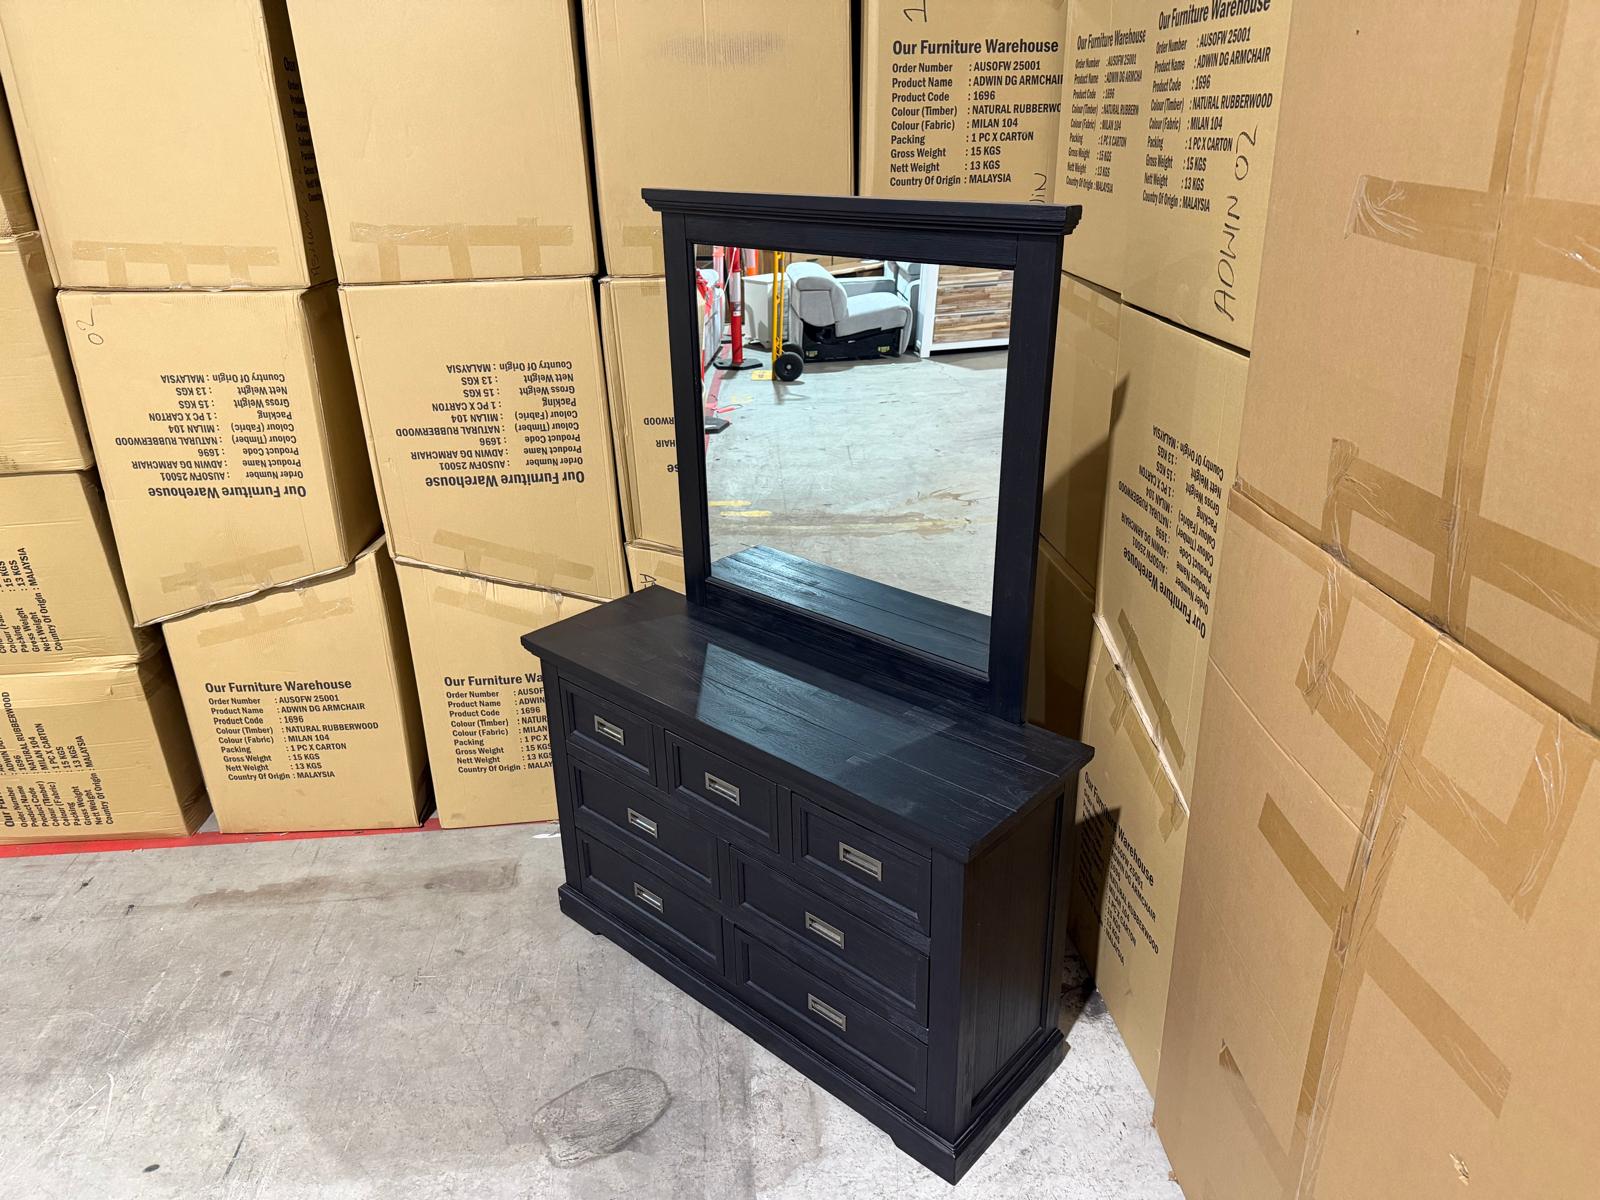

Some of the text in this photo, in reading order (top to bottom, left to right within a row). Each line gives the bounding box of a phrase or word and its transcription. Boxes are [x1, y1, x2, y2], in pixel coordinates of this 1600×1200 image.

[1158, 11, 1171, 30] Our
[1171, 4, 1209, 27] Furniture
[1077, 28, 1146, 50] Our Furniture Warehouse
[1156, 41, 1168, 54] Order
[1168, 37, 1187, 52] Number
[1227, 26, 1251, 44] 25001
[892, 38, 1058, 55] Our Furniture Warehouse
[892, 60, 1040, 73] Order Number AUSOFW 25001
[1153, 59, 1170, 73] Product
[1170, 58, 1185, 71] Name
[1218, 51, 1229, 66] DG
[1229, 46, 1271, 65] ARMCHAIR
[892, 77, 926, 88] Product
[927, 77, 952, 87] Name
[972, 75, 1002, 86] ADWIN
[1004, 75, 1017, 85] DG
[1152, 78, 1168, 92] Product
[1168, 77, 1181, 91] Code
[891, 90, 995, 102] Product Code 1696
[1150, 98, 1164, 111] Colour
[1163, 97, 1184, 113] (Timber)
[1220, 92, 1272, 109] RUBBERWOOD
[891, 106, 920, 116] Colour
[921, 105, 957, 118] (Timber)
[972, 104, 1011, 114] NATURAL
[891, 117, 1018, 131] Colour (Fabric) MILAN 104
[1148, 117, 1162, 129] Colour
[1162, 116, 1181, 132] (Fabric)
[1209, 116, 1222, 130] 104
[890, 131, 1033, 146] Packing 1 PC X CARTON
[890, 145, 1000, 159] Gross Weight 15 KGS
[890, 159, 1000, 174] Nett Weight 13 KGS
[889, 173, 1011, 187] Country Of Origin MALAYSIA
[1214, 124, 1259, 321] ADWIN 02
[445, 359, 572, 373] Country Of Origin MALAYSIA
[396, 421, 579, 436] Colour (Timber) NATURAL RUBBERWOOD
[115, 433, 296, 445] Colour (Timber) NATURAL RUBBERWOOD
[197, 447, 299, 456] Product Code 1696
[410, 445, 581, 459] Product Name ADWIN DG ARMCHAIR
[131, 458, 301, 468] Product Name ADWIN DG ARMCHAIR
[438, 456, 583, 470] Order Number AUSOFW 25001
[159, 470, 303, 481] Order Number AUSOFW 25001
[425, 470, 584, 488] Our Furniture Warehouse
[147, 485, 306, 498] Our Furniture Warehouse
[18, 548, 63, 651] Country Of Origin MALAYSIA
[1123, 547, 1205, 638] Our Furniture Warehouse
[205, 680, 351, 692] Our Furniture Warehouse
[444, 676, 465, 686] Our
[467, 675, 522, 686] Furniture
[208, 697, 229, 705] Order
[279, 695, 311, 703] AUSOFW
[313, 694, 339, 702] 25001
[241, 706, 263, 714] Name
[281, 705, 307, 713] ADWIN
[308, 704, 320, 712] DG
[322, 702, 365, 711] ARMCHAIR
[449, 709, 479, 717] Product
[213, 715, 303, 725] Product Code 1696
[241, 726, 273, 735] (Timber)
[321, 722, 378, 731] RUBBERWOOD
[478, 728, 508, 737] (Fabric)
[76, 736, 93, 767] MALAYSIA
[90, 773, 102, 791] Origin
[100, 801, 114, 825] Country
